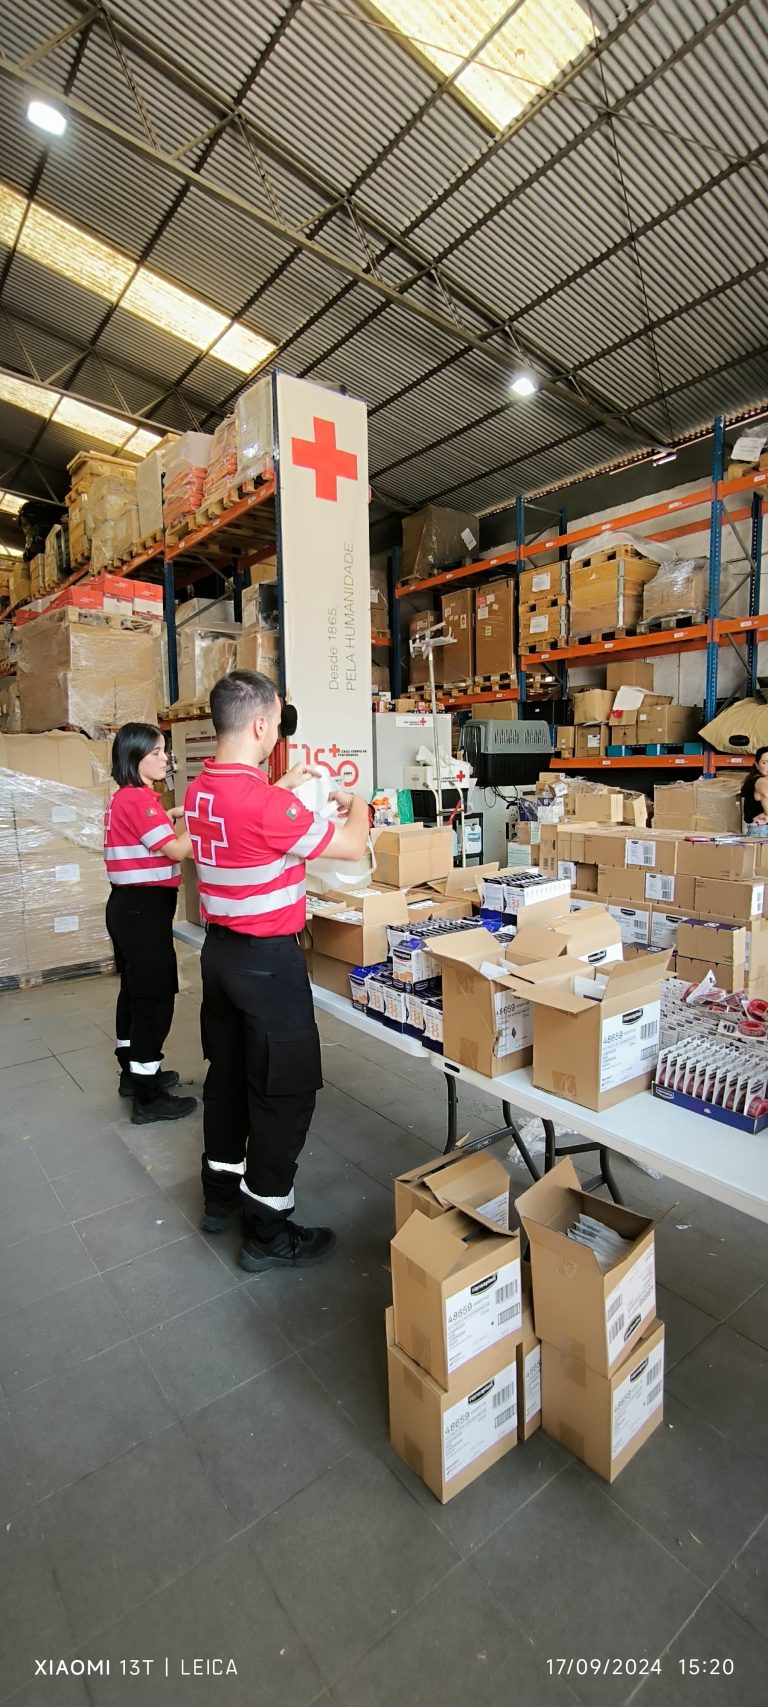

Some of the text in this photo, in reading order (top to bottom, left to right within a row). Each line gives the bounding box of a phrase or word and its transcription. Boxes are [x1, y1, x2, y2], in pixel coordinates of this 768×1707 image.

[343, 541, 357, 691] PELA HUMANIDADE
[327, 607, 339, 690] Desde 1865
[448, 1302, 473, 1323] 48659
[445, 1411, 470, 1434] 48659
